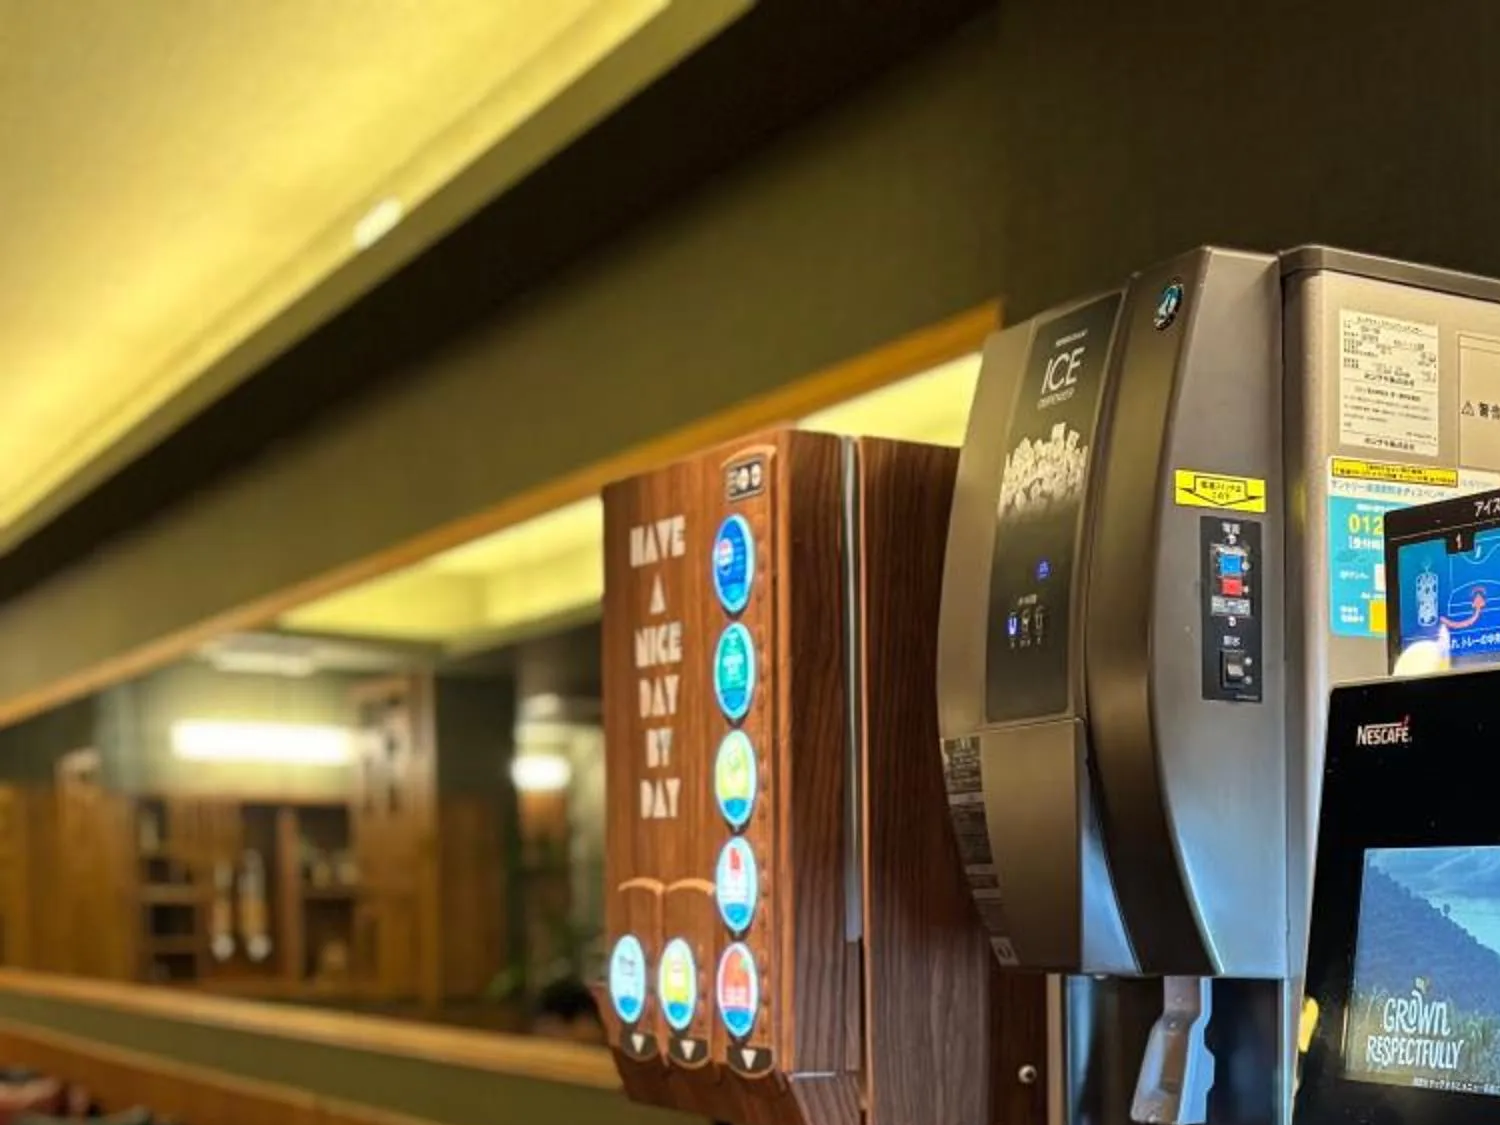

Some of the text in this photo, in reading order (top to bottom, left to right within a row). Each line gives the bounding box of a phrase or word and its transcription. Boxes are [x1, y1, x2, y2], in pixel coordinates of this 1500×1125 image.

[1041, 346, 1086, 395] ICE
[629, 514, 686, 568] HAVE
[1455, 532, 1462, 550] 1
[650, 572, 667, 615] A
[634, 620, 682, 669] NICE
[639, 674, 680, 719] DAY
[645, 726, 673, 769] BY
[640, 777, 681, 820] DAY
[1366, 1034, 1465, 1071] RESPECTFULLY
